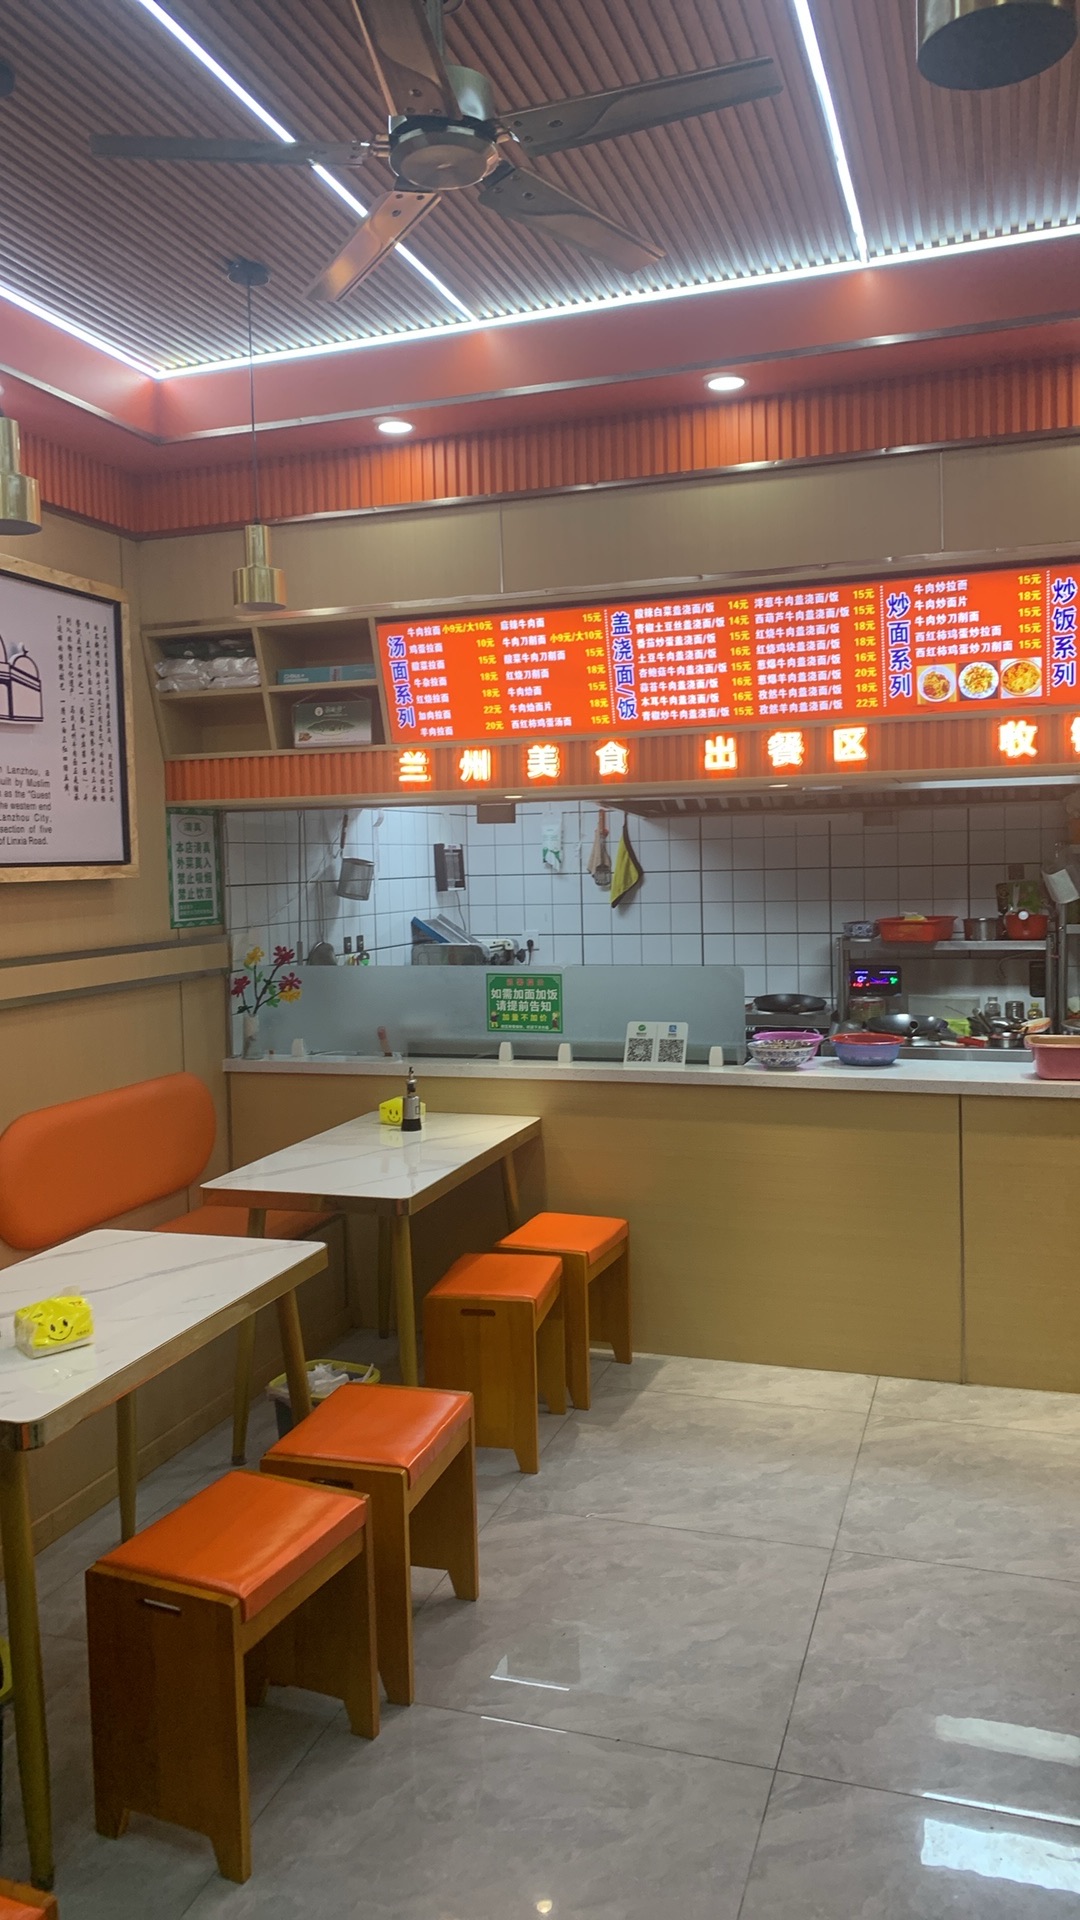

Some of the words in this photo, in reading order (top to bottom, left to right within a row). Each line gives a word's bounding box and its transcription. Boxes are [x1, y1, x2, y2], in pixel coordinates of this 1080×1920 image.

[914, 580, 968, 595] 牛肉炒拉面
[1018, 574, 1041, 585] 15元
[728, 599, 748, 610] 14元
[754, 592, 839, 608] 洋葱牛肉盖浇面/饭
[853, 589, 875, 599] 15元
[914, 596, 968, 610] 牛肉炒面片
[1018, 590, 1041, 601] 18元
[583, 613, 602, 622] 15元
[728, 615, 749, 625] 14元
[754, 606, 850, 624] 西葫芦牛肉盖浇面/饭
[854, 605, 875, 615] 15元
[914, 611, 979, 627] 牛肉炒刀削面
[1018, 607, 1041, 617] 15元
[407, 626, 441, 637] 牛肉拉面
[443, 621, 493, 634] 小9元/大10元
[729, 631, 750, 641] 15元
[755, 623, 840, 639] 红烧牛肉盖浇面/饭
[854, 620, 875, 630] 18元
[915, 625, 1002, 642] 西红柿鸡蛋炒拉面
[1019, 623, 1041, 633] 15元
[1052, 578, 1078, 687] 炒饭系列
[410, 643, 443, 654] 鸡蛋拉面
[477, 638, 495, 647] 10元
[502, 635, 546, 647] 牛肉刀削面
[550, 630, 603, 643] 小9元/大10元
[756, 639, 840, 654] 红烧鸡块盖浇面/饭
[854, 636, 876, 646] 18元
[887, 592, 912, 698] 炒面系列
[504, 650, 566, 664] 酸菜牛肉刀削面
[585, 648, 604, 657] 15元
[638, 648, 716, 664] 土豆牛肉盖浇面/饭
[730, 646, 750, 656] 16元
[916, 641, 1013, 658] 西红柿鸡蛋炒刀削面
[1019, 639, 1041, 649] 15元
[411, 660, 445, 671] 酸菜拉面
[479, 655, 497, 664] 15元
[855, 652, 876, 662] 16元
[506, 669, 549, 680] 红烧刀削面
[587, 664, 605, 674] 18元
[611, 612, 638, 719] 盖浇面/饭
[731, 661, 751, 671] 15元
[855, 667, 877, 677] 20元
[387, 635, 416, 729] 汤面系列
[414, 677, 447, 687] 牛杂拉面
[480, 672, 498, 681] 18元
[588, 682, 607, 691] 15元
[732, 677, 752, 686] 16元
[416, 694, 449, 704] 红烧拉面
[482, 689, 500, 698] 18元
[641, 693, 719, 706] 木耳牛肉盖浇面/饭
[733, 691, 753, 701] 16元
[758, 685, 842, 700] 孜然牛肉盖浇面/饭
[856, 683, 877, 692] 18元
[590, 698, 608, 708] 18元
[734, 706, 754, 716] 15元
[759, 699, 842, 715] 孜然羊肉盖浇面/饭
[856, 698, 878, 708] 22元
[418, 710, 451, 720] 加肉拉面
[484, 705, 502, 714] 22元
[421, 726, 453, 737] 羊肉拉面
[486, 721, 504, 730] 20元
[512, 717, 572, 729] 西红柿鸡蛋汤面
[591, 715, 610, 725] 15元
[704, 726, 867, 771] 出餐区
[398, 741, 629, 782] 兰州美食
[15, 778, 23, 788] by
[15, 790, 25, 798] the
[176, 842, 210, 854] 本店清真
[178, 872, 212, 884] 禁止吸烟
[178, 887, 213, 900] 禁止饮酒
[491, 988, 558, 1000] 如需加面加饭
[496, 1000, 551, 1012] 请提前告知
[502, 1013, 547, 1021] 加量不加价
